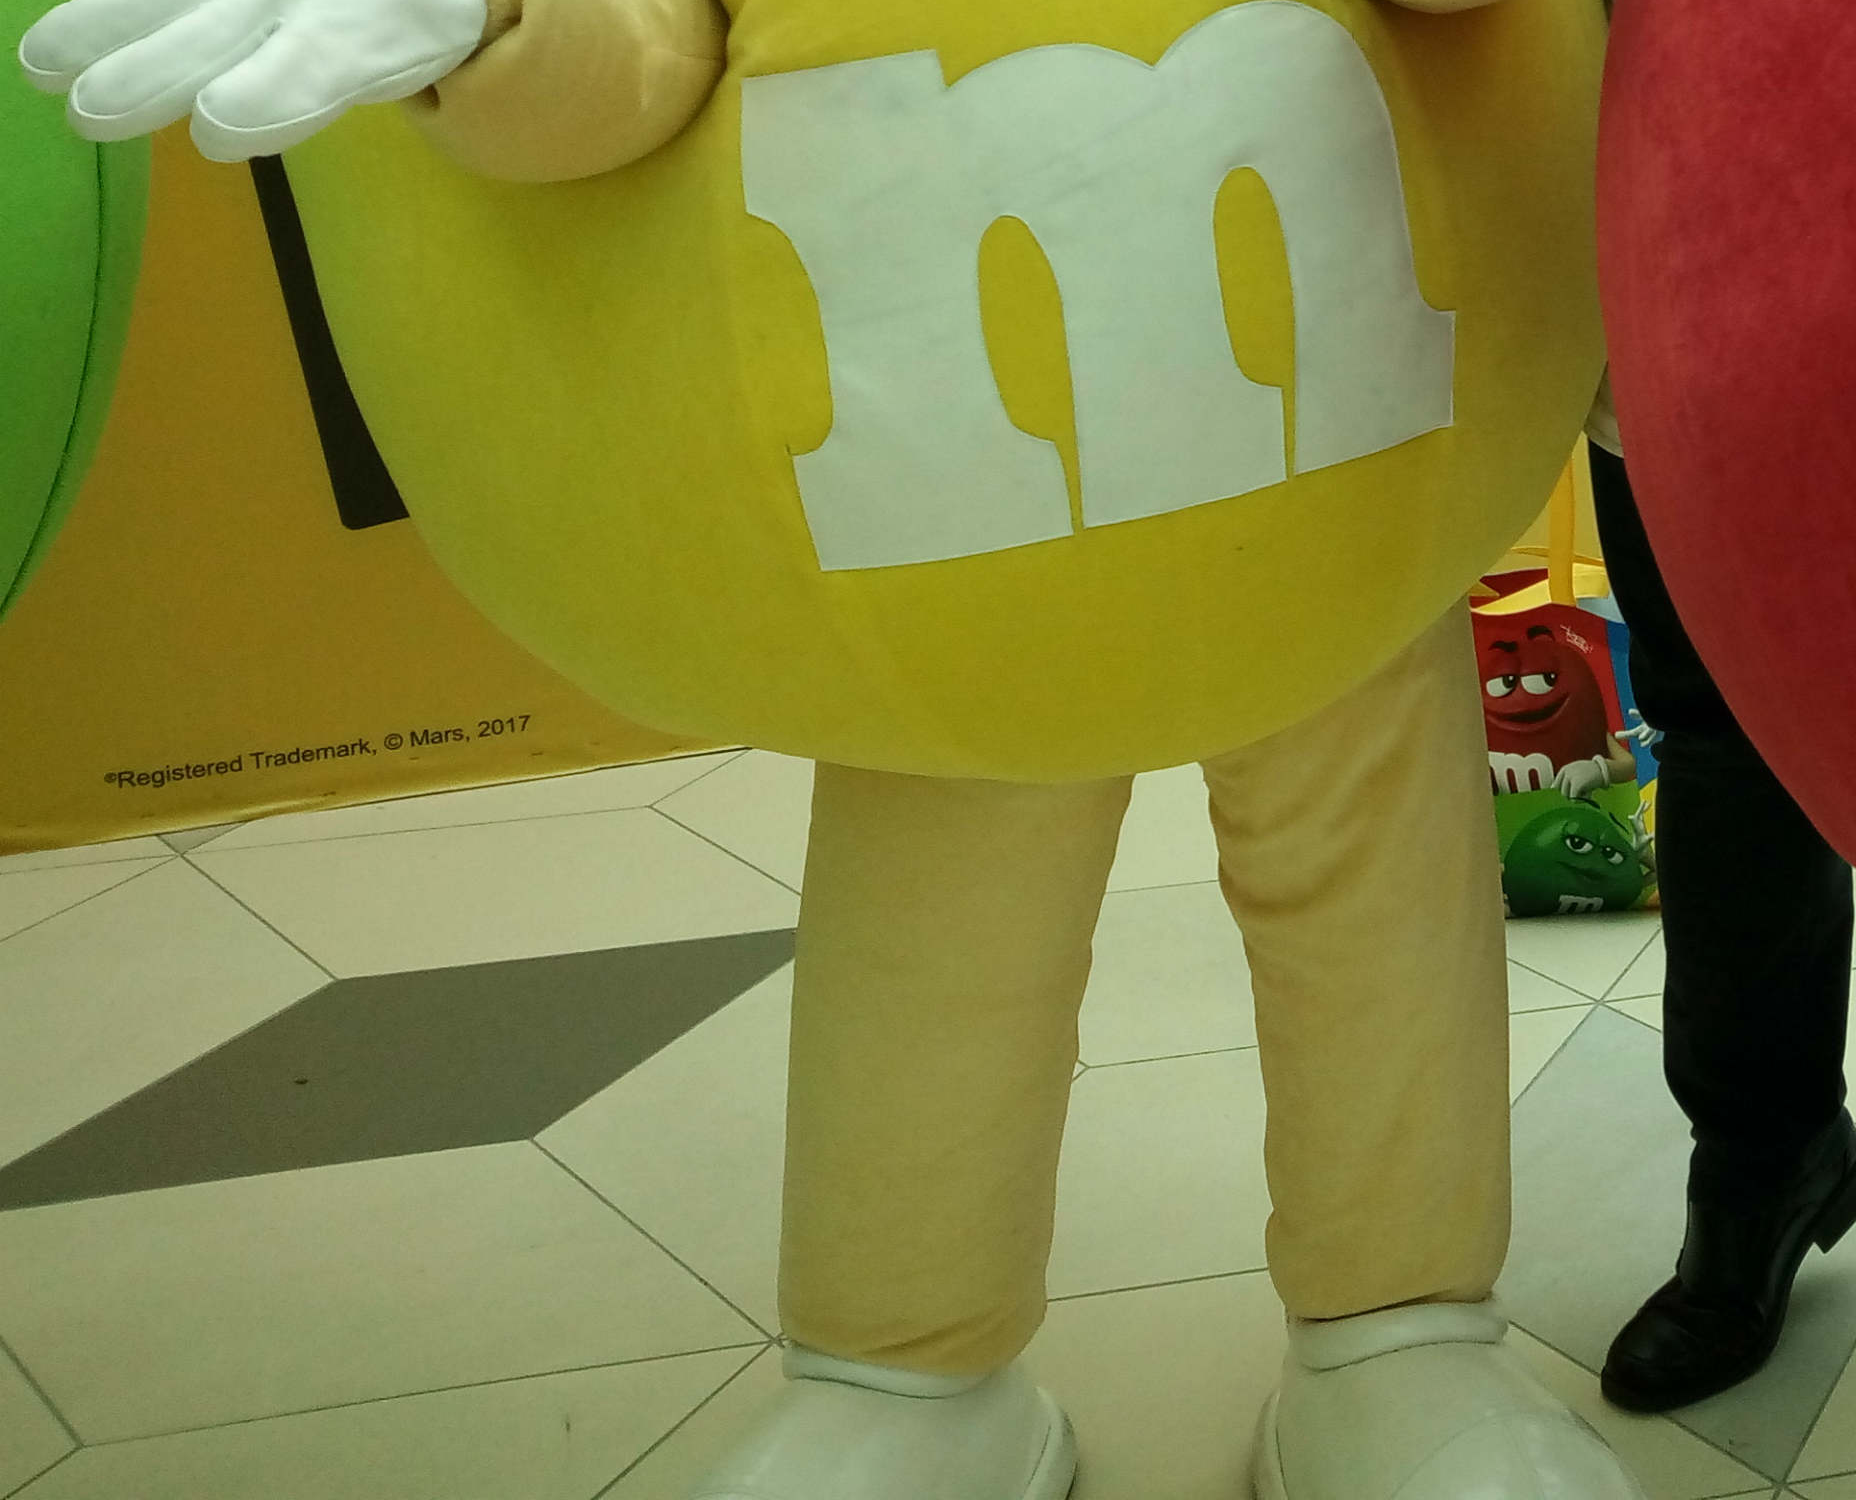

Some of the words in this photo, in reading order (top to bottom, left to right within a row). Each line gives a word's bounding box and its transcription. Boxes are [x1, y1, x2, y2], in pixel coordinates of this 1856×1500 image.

[249, 738, 377, 769] Trademark,
[410, 728, 470, 748] Mars,
[478, 715, 531, 738] 2017
